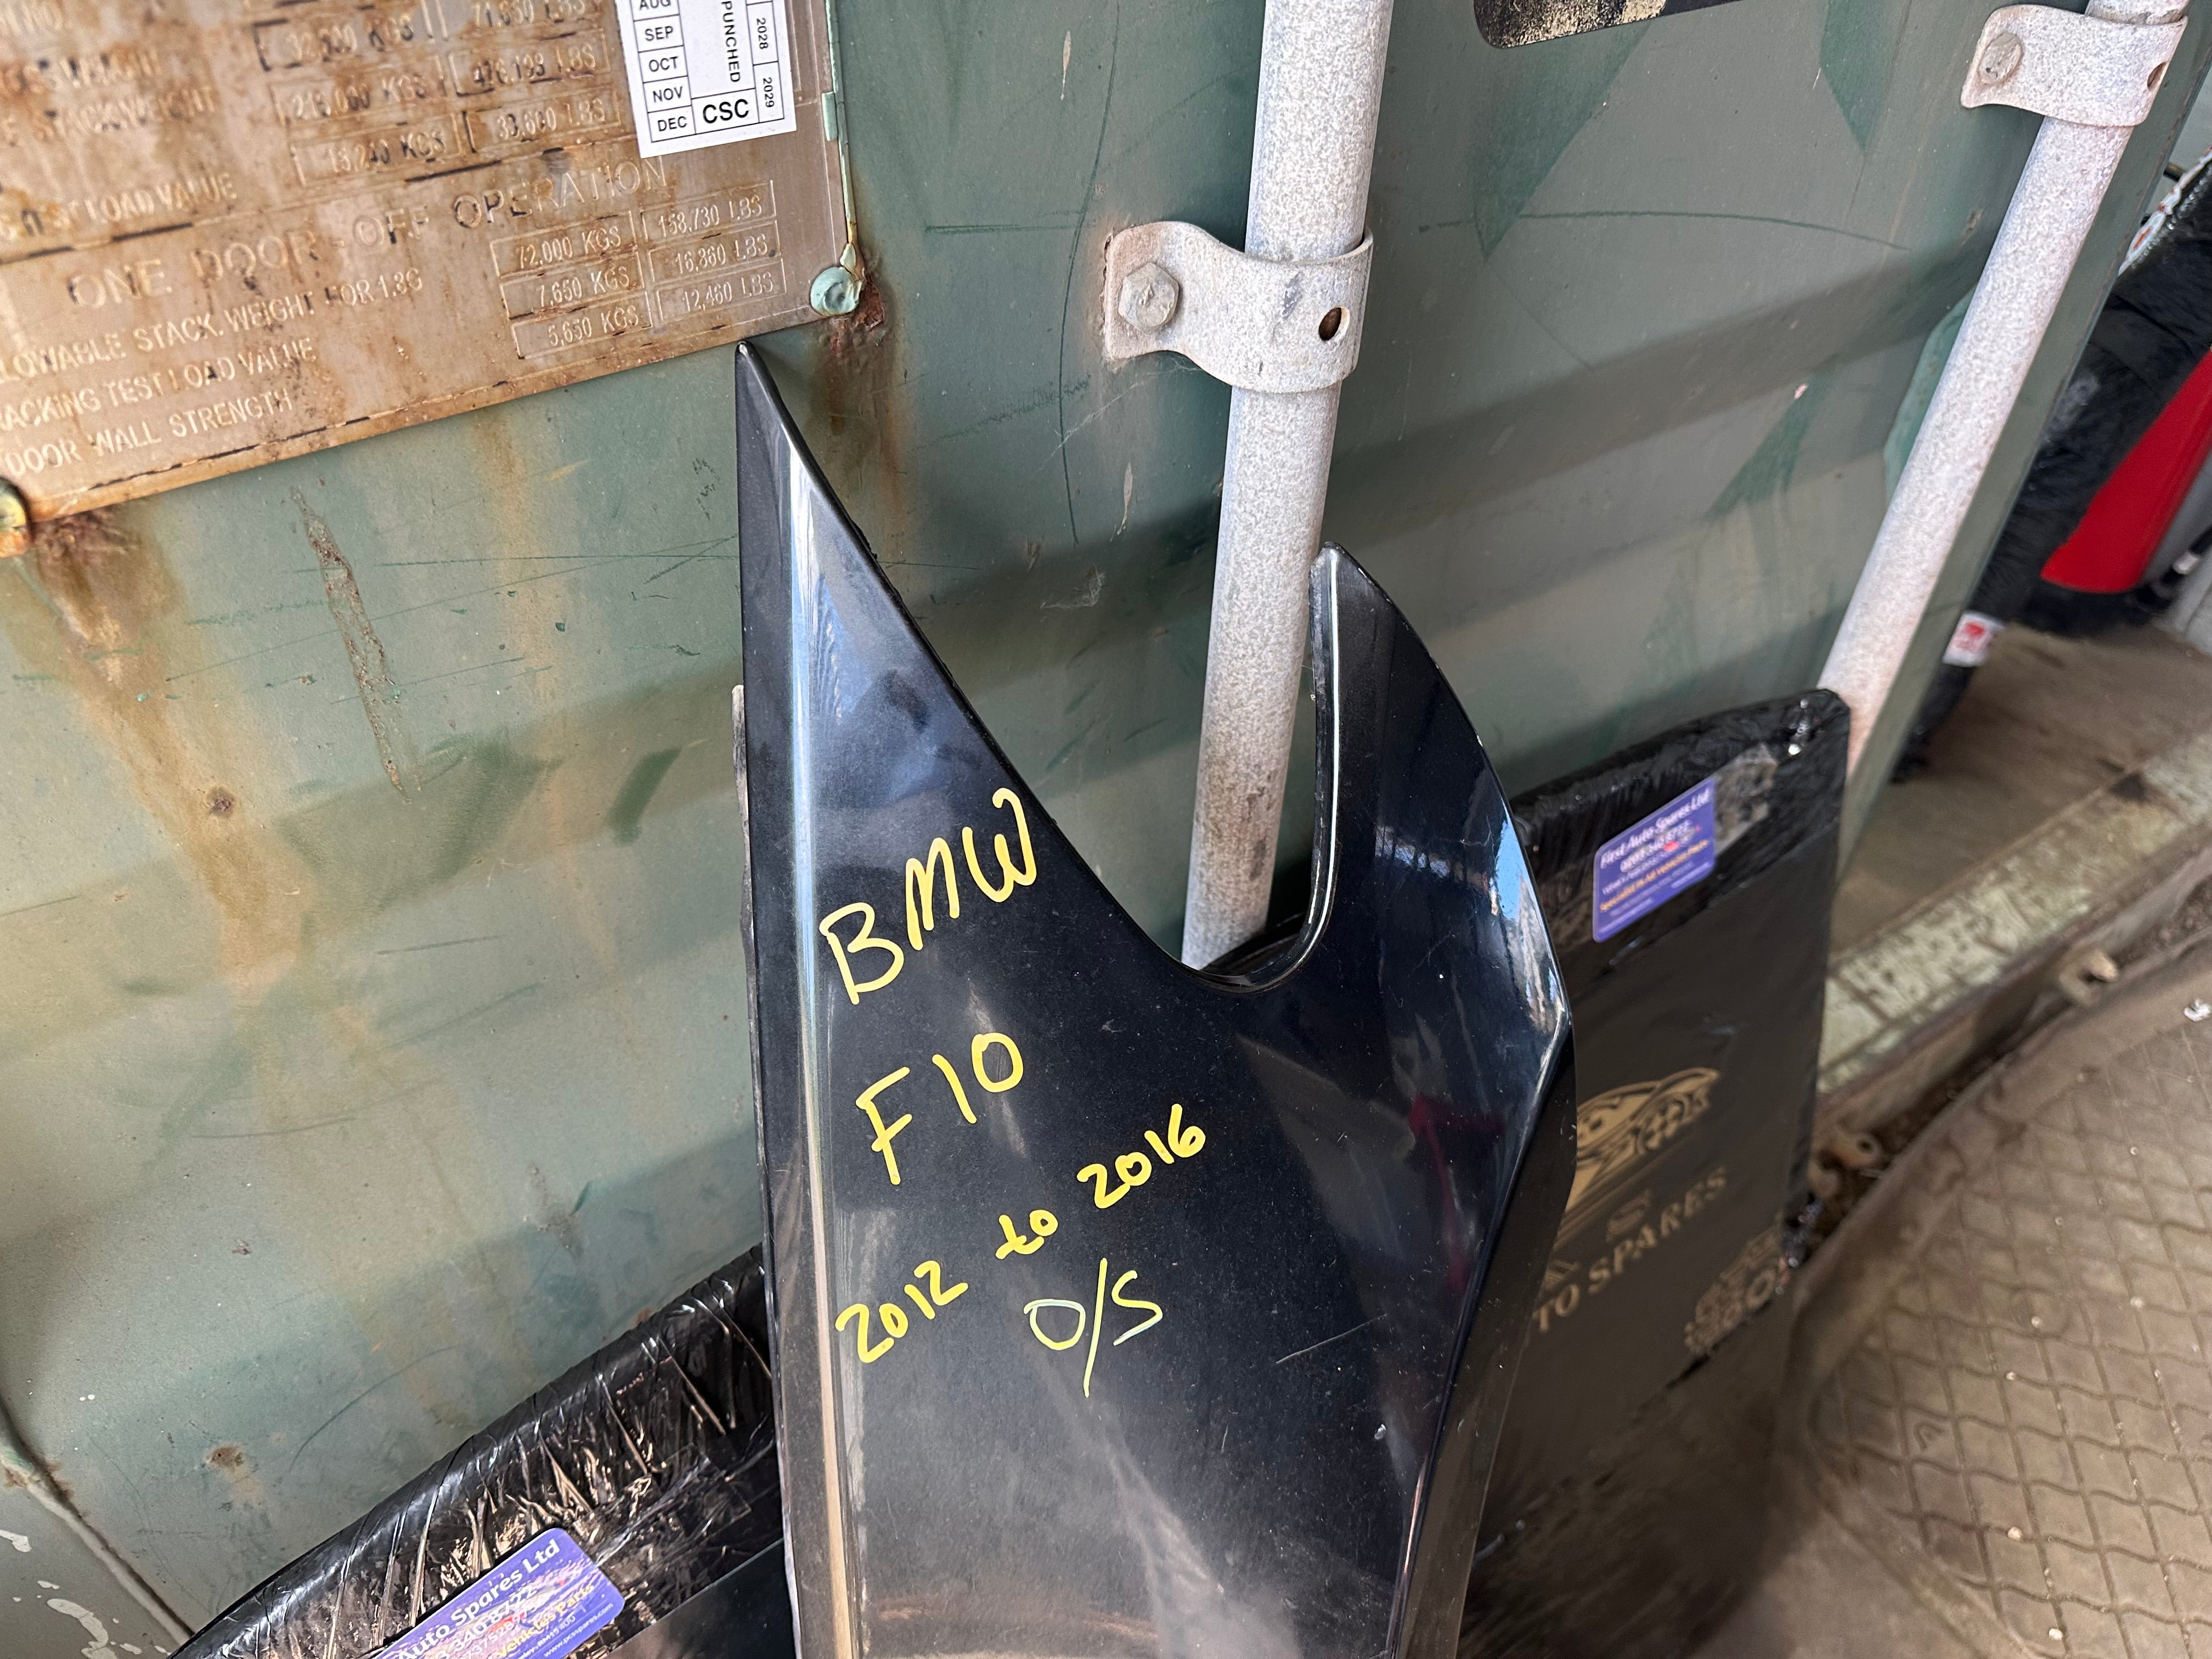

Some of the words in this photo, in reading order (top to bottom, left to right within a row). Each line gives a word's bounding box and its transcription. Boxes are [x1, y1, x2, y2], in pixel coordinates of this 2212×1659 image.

[639, 0, 672, 11] AUG
[644, 25, 674, 41] SEP
[721, 1, 741, 83] PUNCHED
[755, 17, 769, 50] 2028
[648, 56, 679, 72] OCT
[652, 86, 684, 103] NOV
[762, 76, 775, 108] 2029
[657, 115, 688, 132] DEC
[702, 98, 750, 125] CSC
[729, 194, 763, 221] LBS
[67, 257, 172, 309] ONE
[453, 156, 668, 228] OPERATION
[582, 225, 622, 255] KGS
[734, 233, 768, 261] LBS
[590, 266, 630, 295] KGS
[741, 271, 774, 299] LBS
[0, 332, 127, 383] LOWABLE
[224, 291, 315, 332] WEIGHT
[324, 279, 375, 307] FOR
[600, 304, 639, 334] KGS
[102, 371, 164, 408] TEST
[168, 357, 236, 393] LOAD
[236, 337, 317, 376] VALUE
[3, 438, 83, 478] DOOR
[86, 420, 163, 458] WALL
[168, 386, 293, 438] STRENGTH
[820, 788, 1037, 1005] BMW
[855, 1032, 1024, 1186] F10
[834, 1260, 969, 1364] 2012
[996, 1209, 1058, 1259] to
[1076, 1103, 1206, 1209] 2016
[1023, 1258, 1163, 1397] O/S
[397, 1624, 450, 1659] Auto
[450, 1568, 523, 1627] Spares
[522, 1538, 561, 1573] Ltd
[555, 1584, 595, 1615] Parts
[450, 1622, 488, 1652] 340
[491, 1585, 538, 1623] 8722
